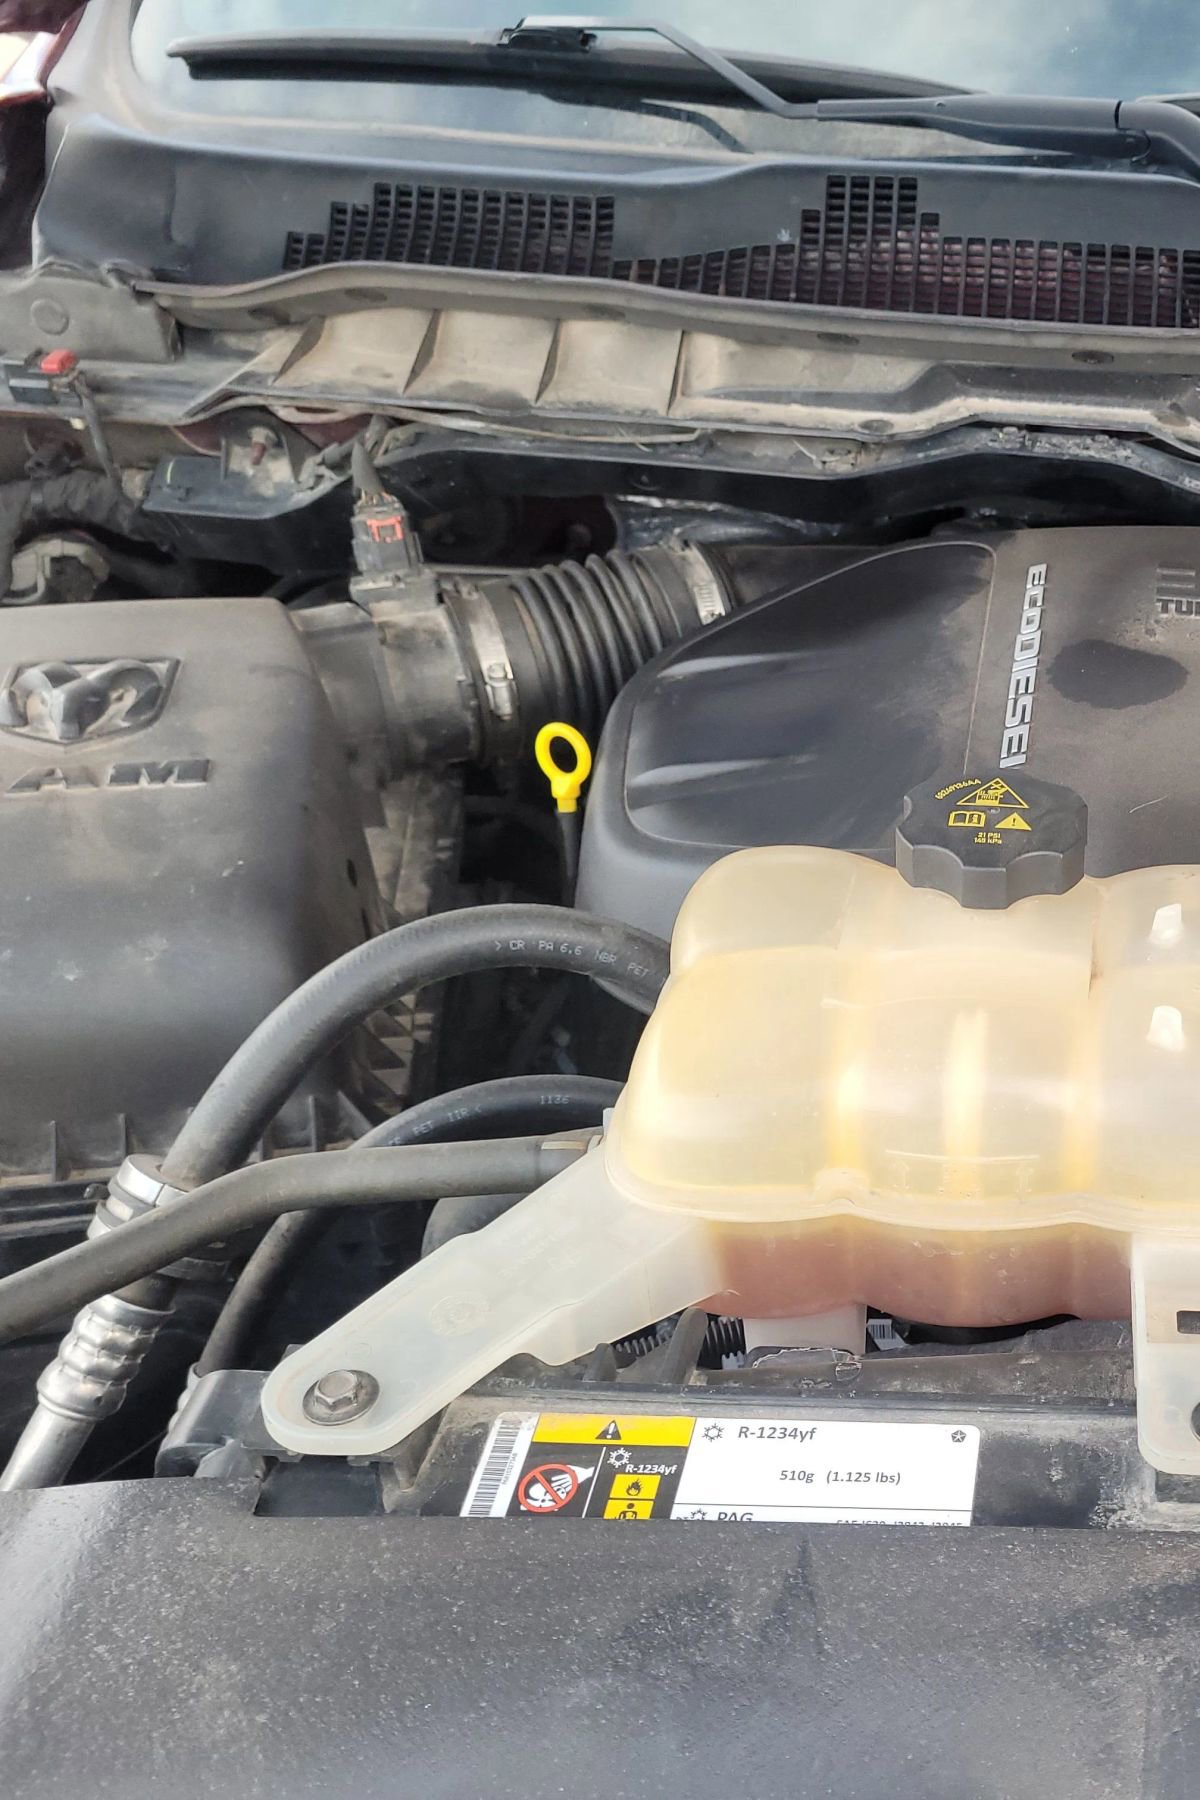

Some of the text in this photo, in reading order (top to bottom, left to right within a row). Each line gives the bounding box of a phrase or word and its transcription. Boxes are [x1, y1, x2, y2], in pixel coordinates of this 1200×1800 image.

[5, 758, 211, 793] AM
[509, 940, 526, 950] CR
[538, 940, 554, 951] PA
[560, 943, 585, 956] 6.6
[594, 949, 617, 966] NBR
[627, 962, 650, 978] PET
[737, 1426, 818, 1442] R-1234yf
[625, 1463, 678, 1476] R-1234yf
[779, 1470, 901, 1485] 510g (1.125 lbs)
[716, 1511, 754, 1521] PAG
